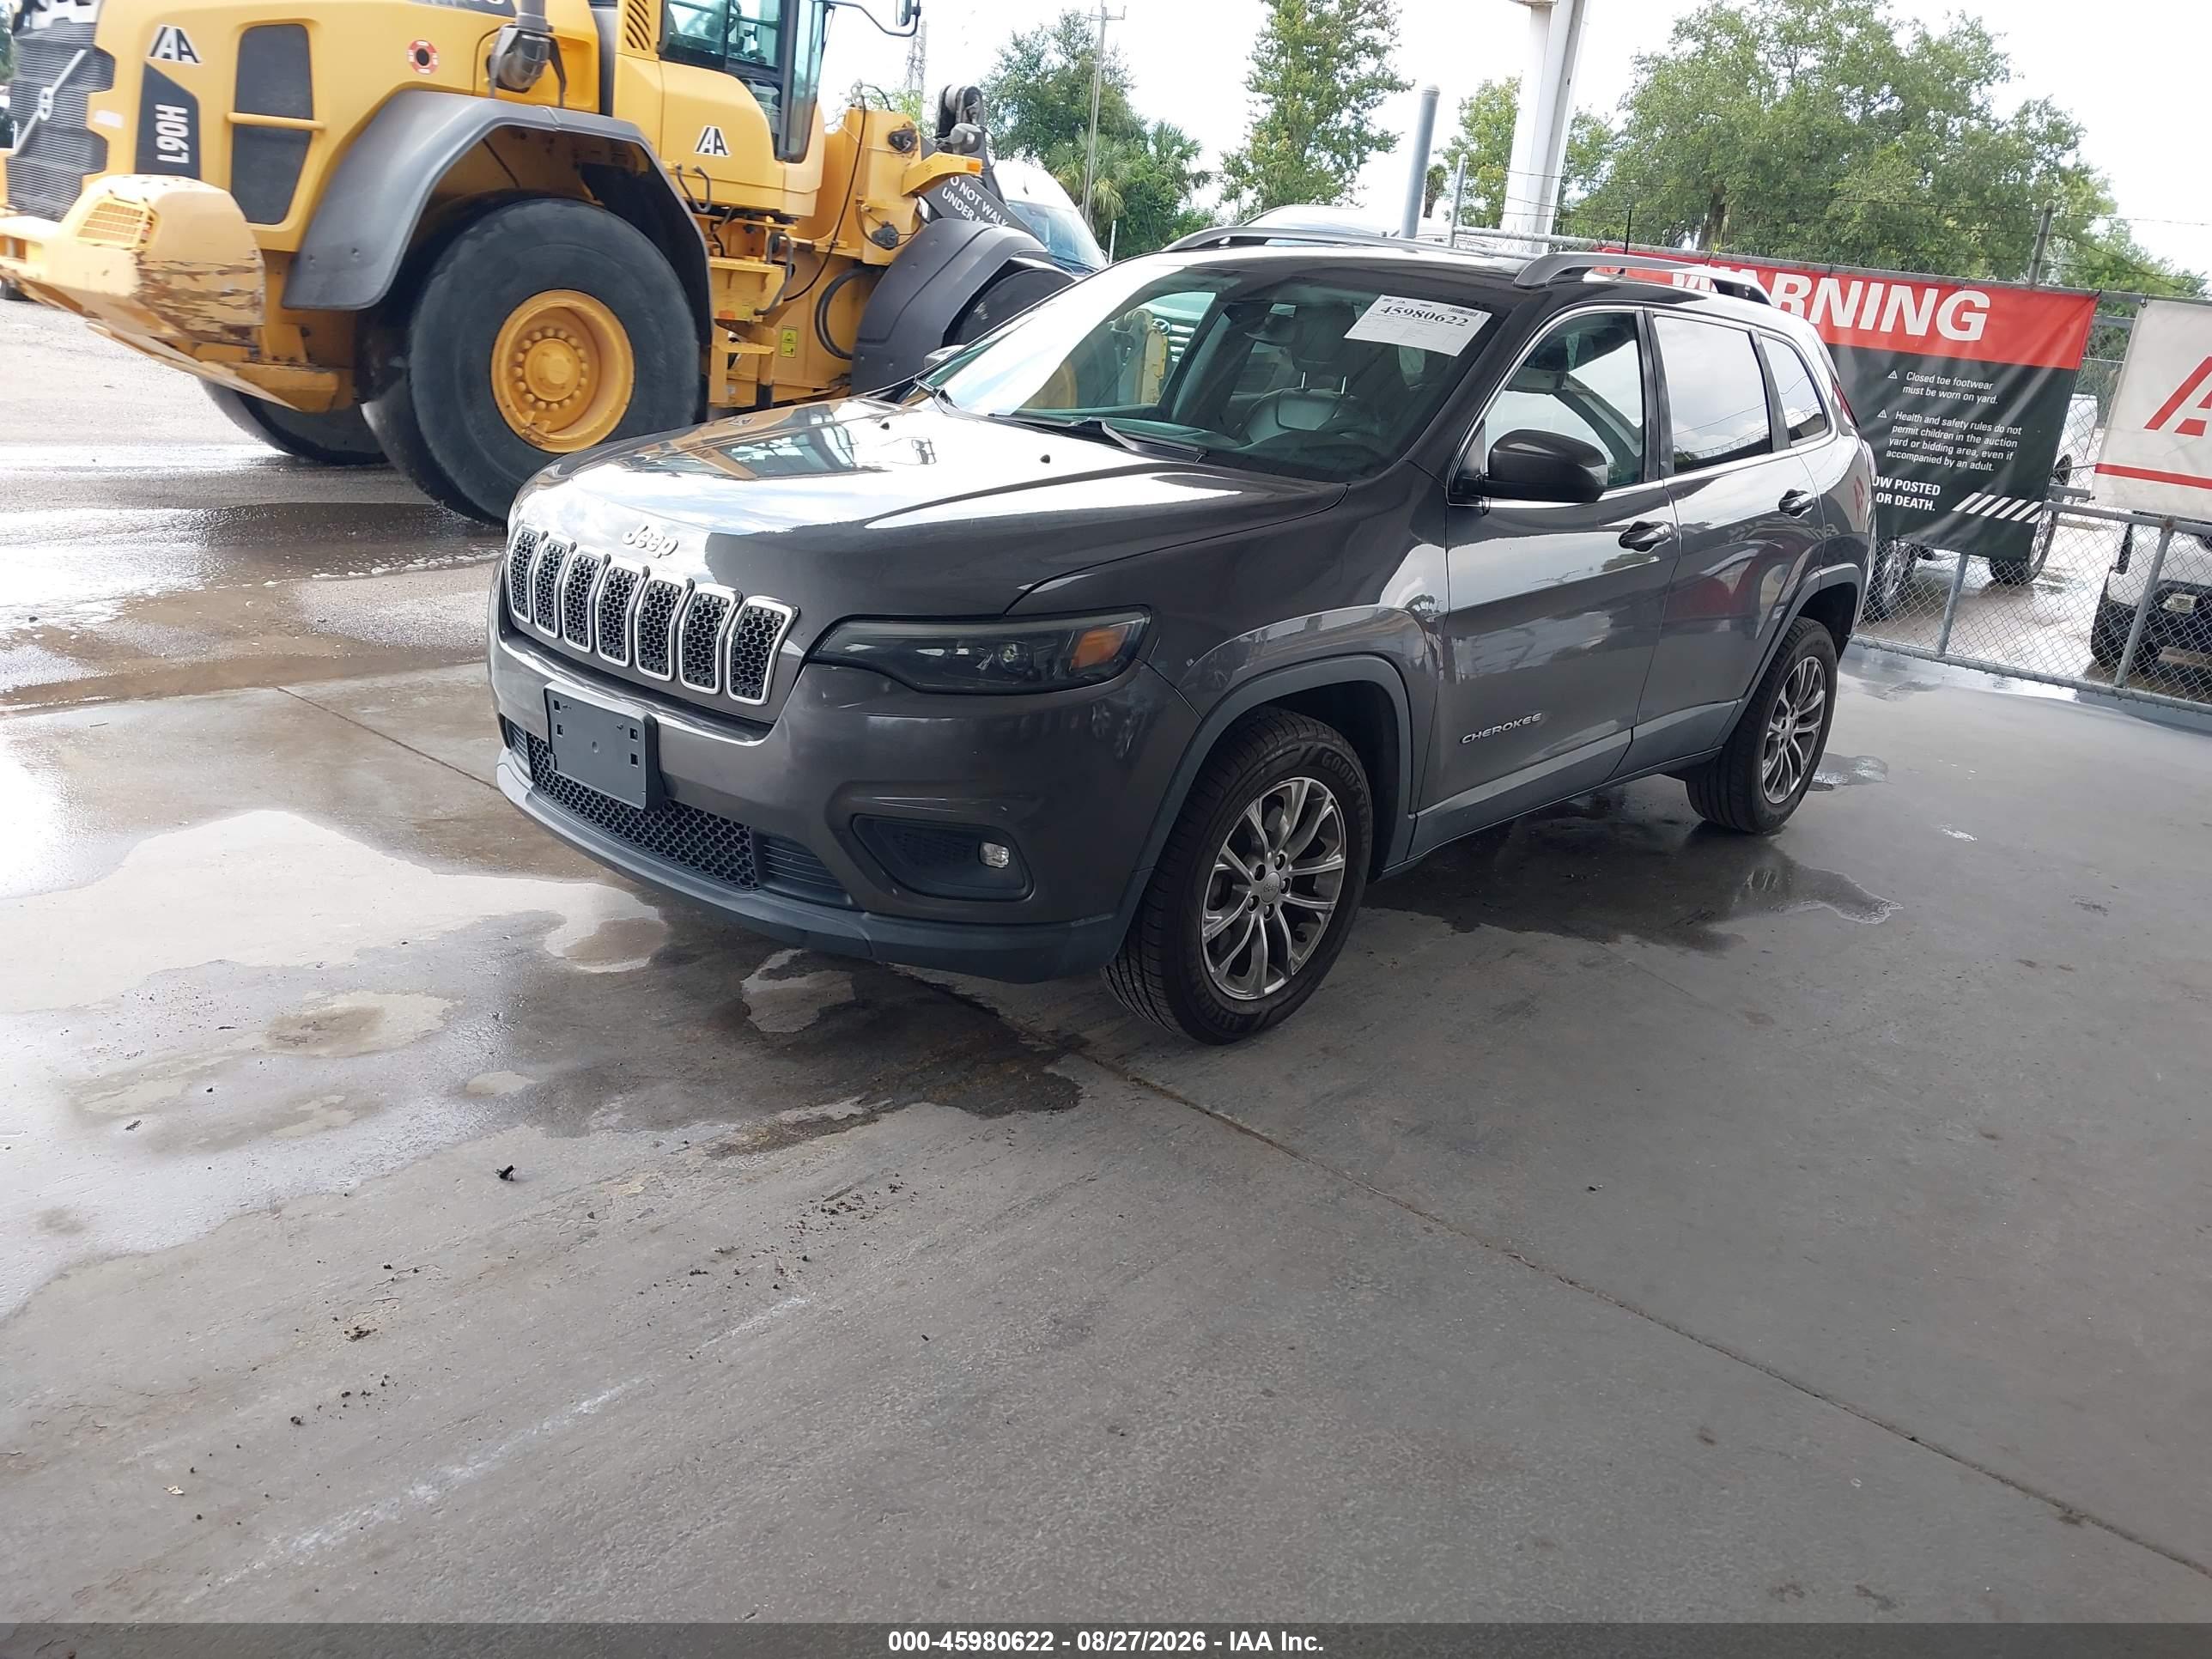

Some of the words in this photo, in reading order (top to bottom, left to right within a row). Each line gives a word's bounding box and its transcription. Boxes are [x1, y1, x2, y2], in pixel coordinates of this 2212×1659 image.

[155, 103, 190, 164] L90H
[941, 187, 975, 222] UNDER
[959, 181, 983, 206] NOT
[981, 201, 1010, 227] WALK
[1672, 264, 1991, 341] RNING
[1380, 305, 1471, 327] 45980622
[1905, 371, 1936, 384] Closed
[1936, 374, 1951, 386] toe
[1953, 376, 1994, 391] footwear
[1902, 386, 1924, 396] must
[1925, 387, 1937, 398] be
[1938, 390, 1961, 400] worn
[1963, 392, 1975, 402] on
[1976, 394, 1999, 405] yard.
[1894, 410, 1923, 423] Health
[1923, 414, 1941, 426] and
[1941, 417, 1969, 430] safety
[1970, 421, 1992, 433] rules
[1994, 423, 2005, 434] do
[2006, 426, 2022, 435] not
[1891, 424, 1919, 436] permit
[1920, 426, 1954, 441] children
[1955, 431, 1965, 441] in
[1966, 433, 1982, 444] the
[1984, 435, 2018, 448] auction
[1886, 449, 1943, 464] accompanied
[1943, 455, 1955, 468] by
[1956, 459, 1968, 469] an
[1969, 459, 1995, 471] adult.
[1888, 437, 1909, 448] yard
[1910, 440, 1921, 448] or
[1922, 441, 1954, 455] bidding
[1956, 446, 1980, 458] area,
[1981, 450, 2004, 460] even
[2006, 451, 2014, 461] if
[1894, 478, 1942, 496] POSTED
[1875, 492, 1893, 505] OR
[1894, 495, 1936, 512] DEATH.
[622, 524, 679, 559] Jeep
[1461, 713, 1543, 744] CHEROKEE
